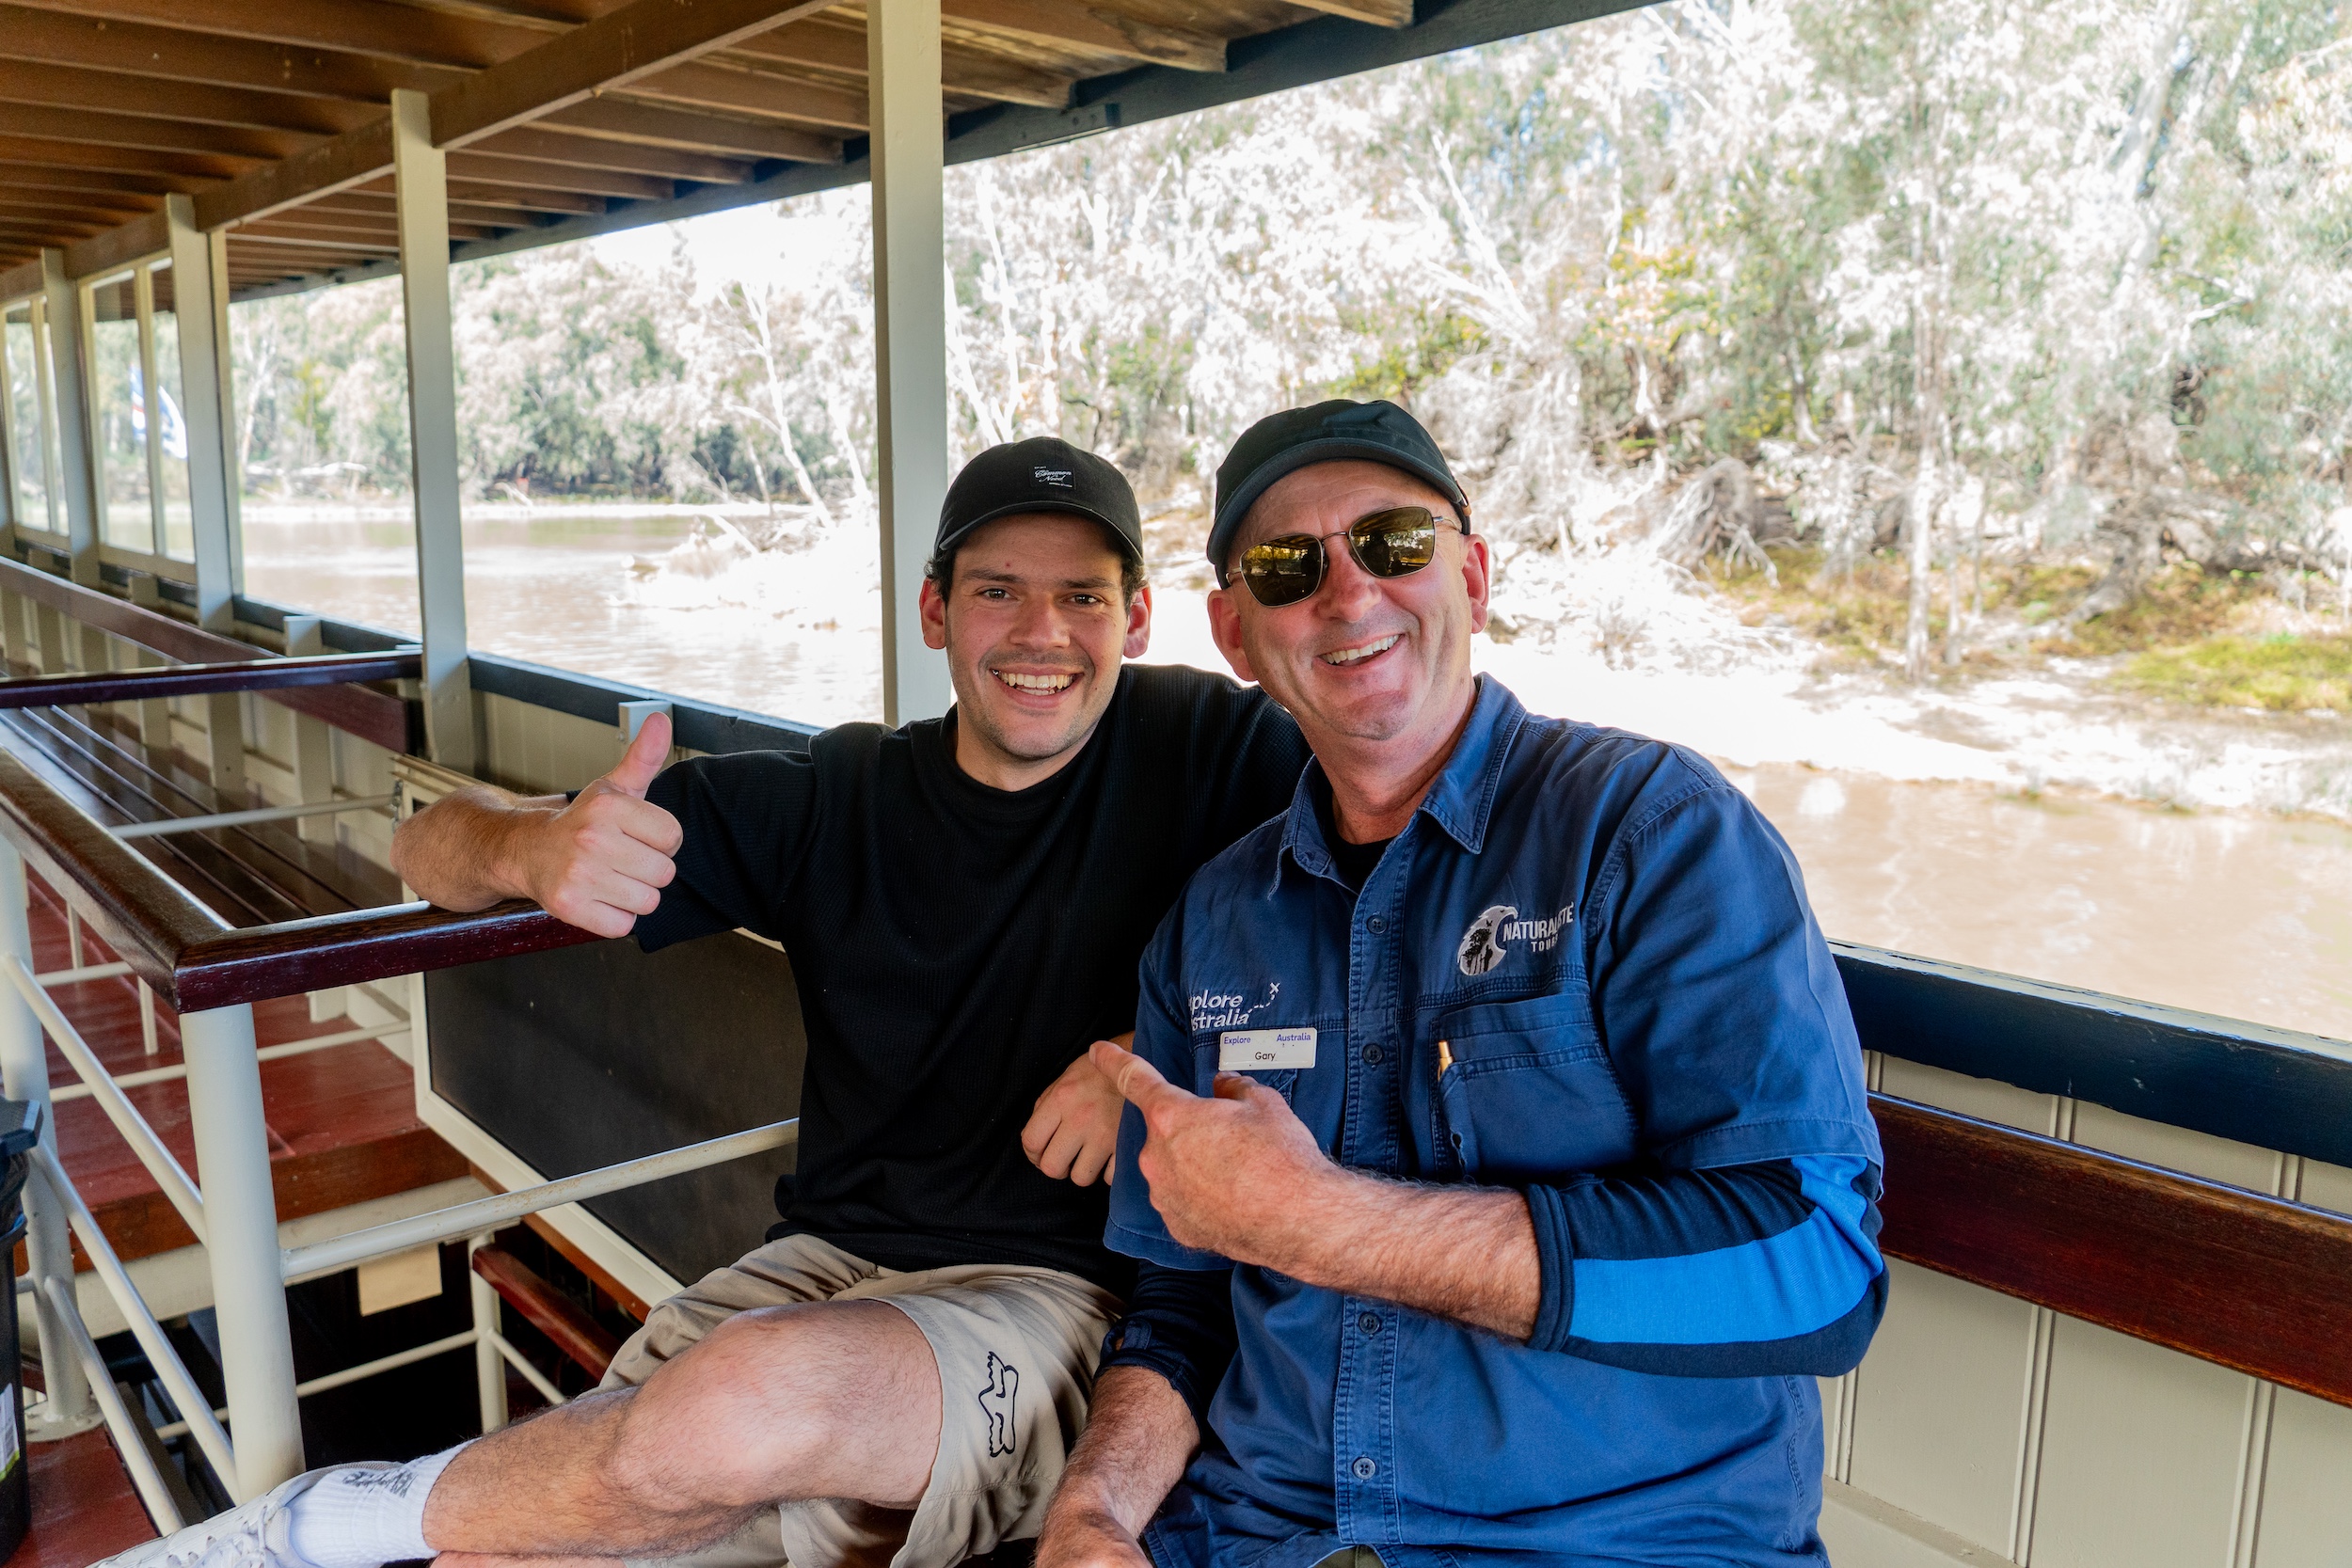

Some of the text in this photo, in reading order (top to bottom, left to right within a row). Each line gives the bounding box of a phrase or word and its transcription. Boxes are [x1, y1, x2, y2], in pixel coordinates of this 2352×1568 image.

[1189, 990, 1243, 1015] plore
[1191, 1007, 1249, 1031] stralia
[1224, 1033, 1311, 1045] Explore Australia
[1254, 1052, 1276, 1062] Gary
